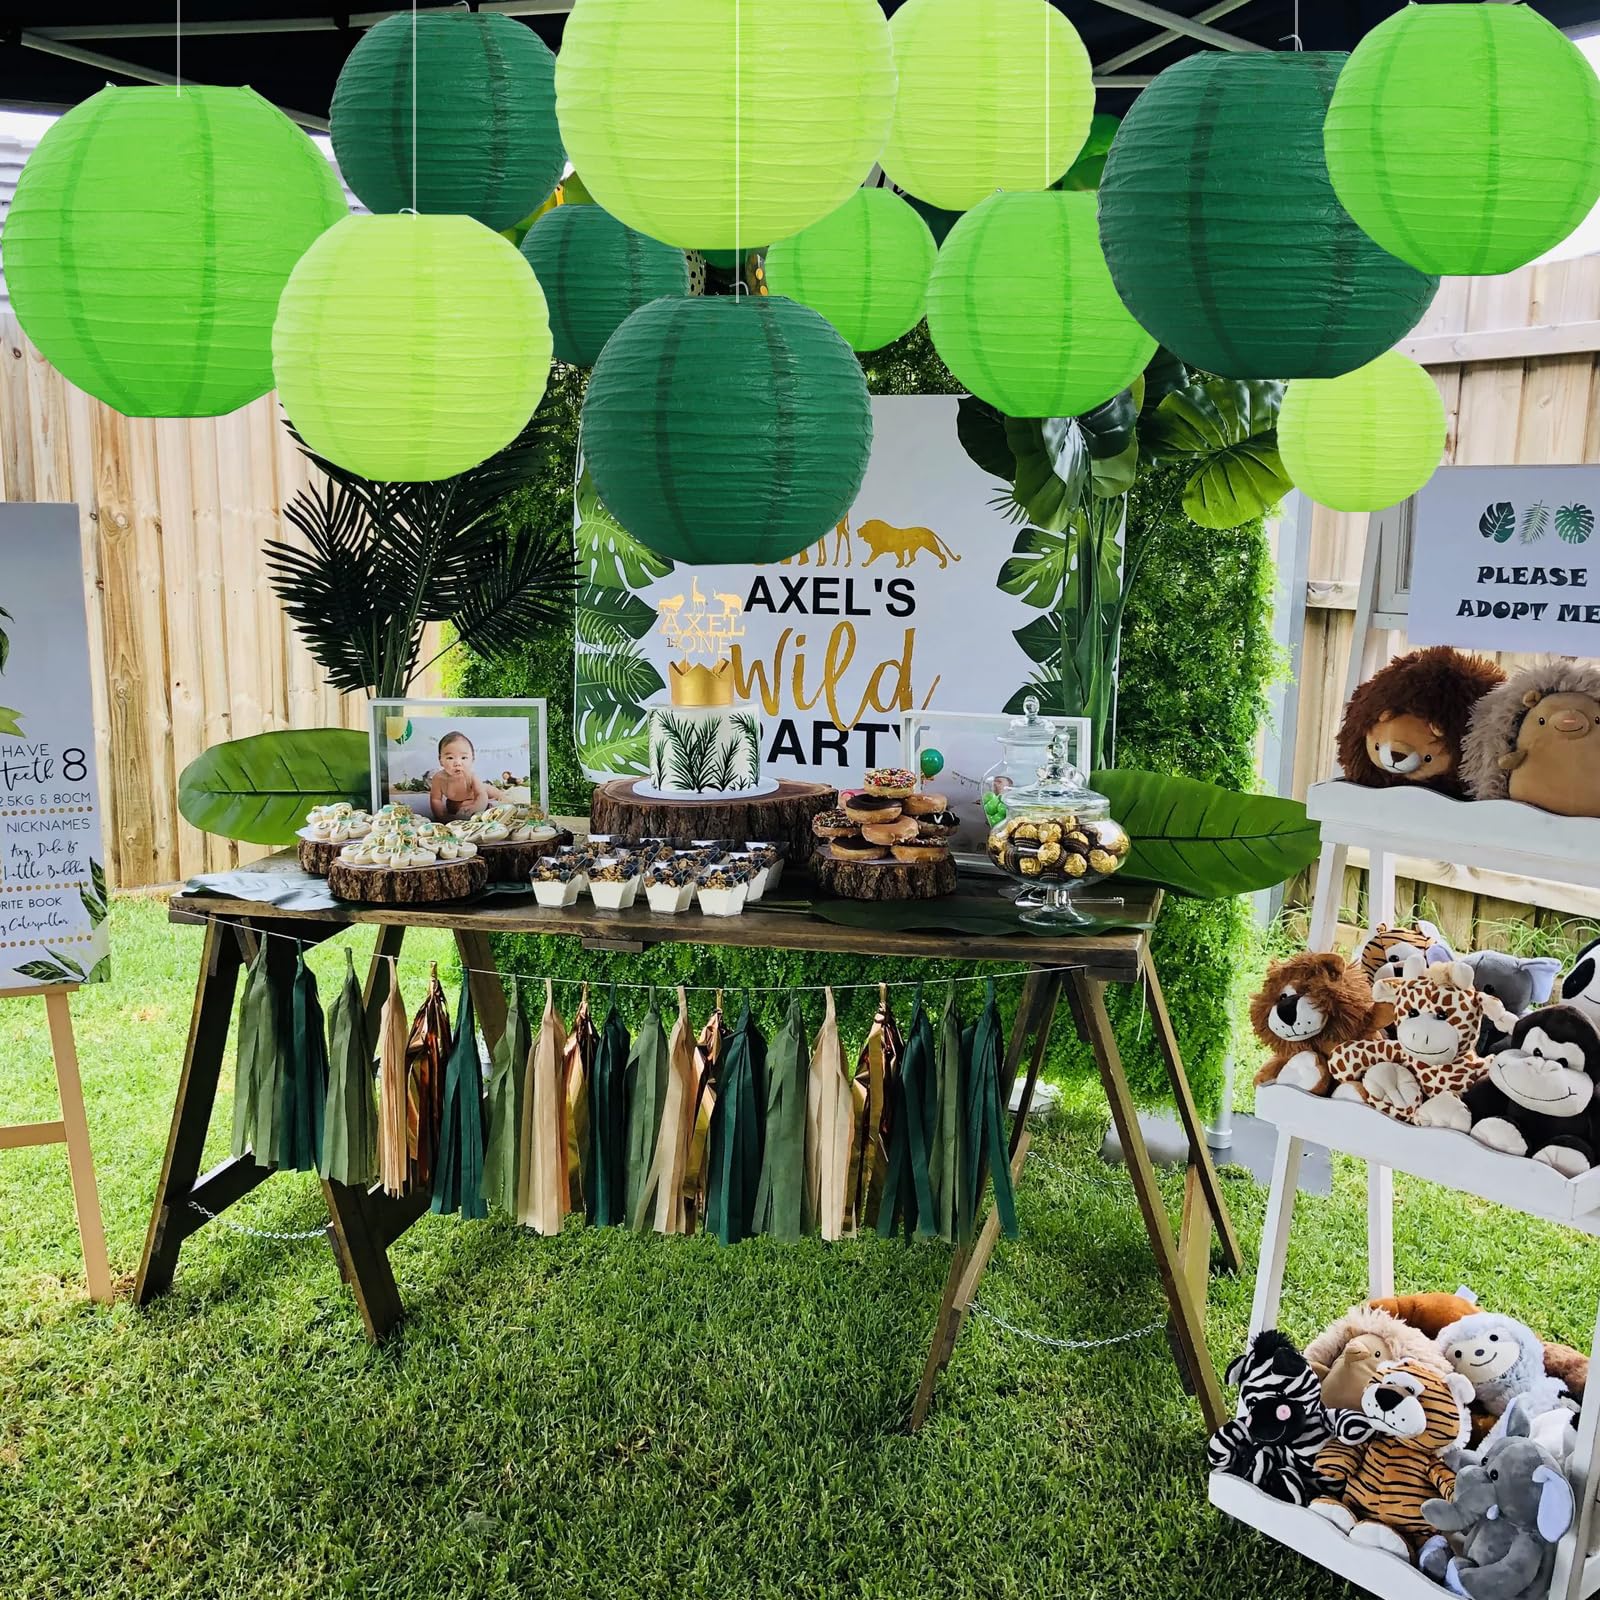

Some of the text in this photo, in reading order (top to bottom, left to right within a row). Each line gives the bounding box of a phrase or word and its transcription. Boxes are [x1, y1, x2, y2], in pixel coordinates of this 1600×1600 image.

[1477, 566, 1587, 587] PLEASE
[743, 575, 916, 617] AXEL'S
[1456, 599, 1600, 624] ADOPT ME
[658, 613, 746, 636] AXEL
[679, 634, 732, 654] ONE
[729, 620, 941, 732] Wild
[2, 743, 50, 758] HAVE
[760, 718, 902, 769] ART
[0, 747, 87, 791] teeth 8
[40, 793, 47, 805] &
[7, 818, 90, 833] NICKNAMES
[67, 840, 79, 854] &
[29, 897, 62, 908] BOOK
